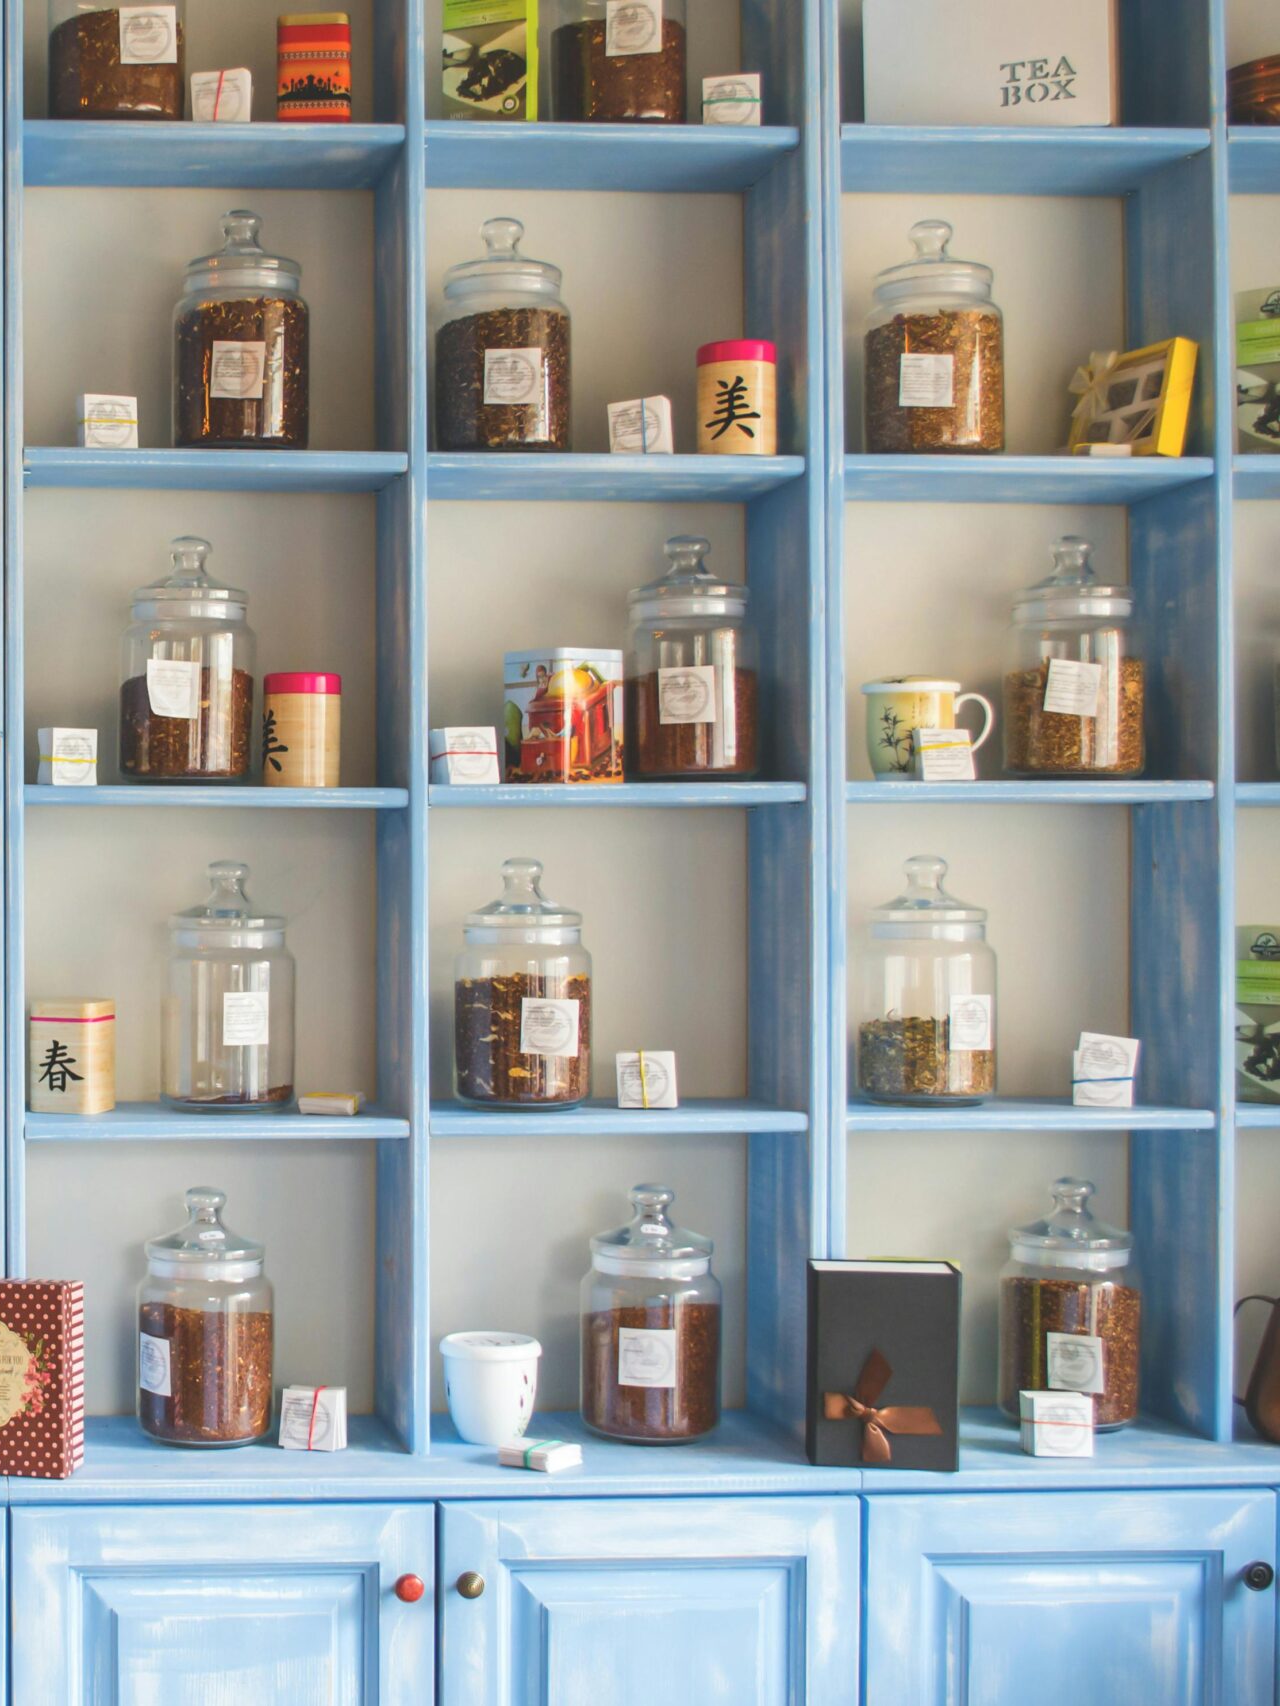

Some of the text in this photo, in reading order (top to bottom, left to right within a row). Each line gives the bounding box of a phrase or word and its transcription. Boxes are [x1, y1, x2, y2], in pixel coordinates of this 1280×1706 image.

[1000, 56, 1077, 83] TEA
[1000, 78, 1077, 107] BOX
[705, 375, 761, 441] 美
[38, 1040, 85, 1093] 春
[2, 1354, 12, 1365] FOR
[13, 1355, 24, 1365] YOU
